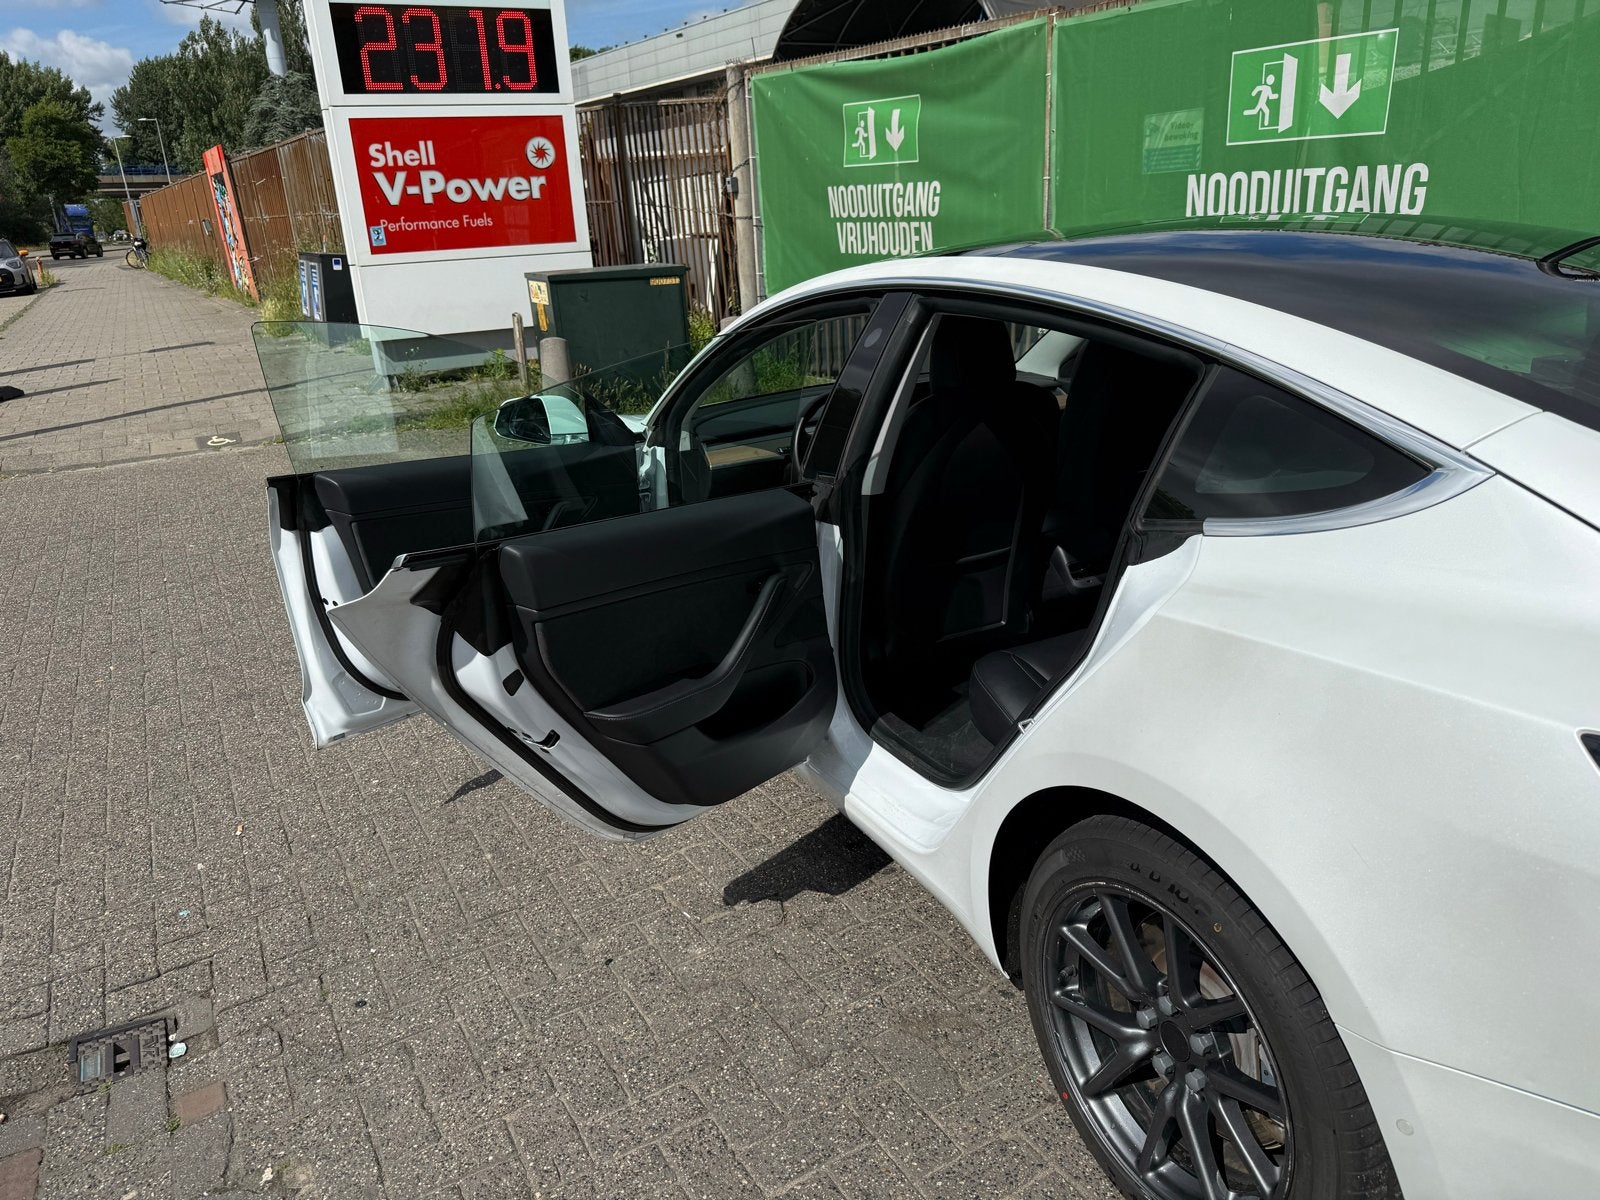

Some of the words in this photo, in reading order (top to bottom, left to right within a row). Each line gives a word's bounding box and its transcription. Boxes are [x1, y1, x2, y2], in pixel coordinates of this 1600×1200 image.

[354, 6, 538, 91] 231.9
[368, 140, 436, 168] Shell
[372, 170, 547, 206] V-Power
[827, 180, 941, 218] NOODUITGANG
[1185, 162, 1429, 218] NOODUITGANG
[380, 216, 460, 232] Performance
[463, 212, 494, 228] Fuels
[836, 221, 934, 257] VRIJHOUDEN
